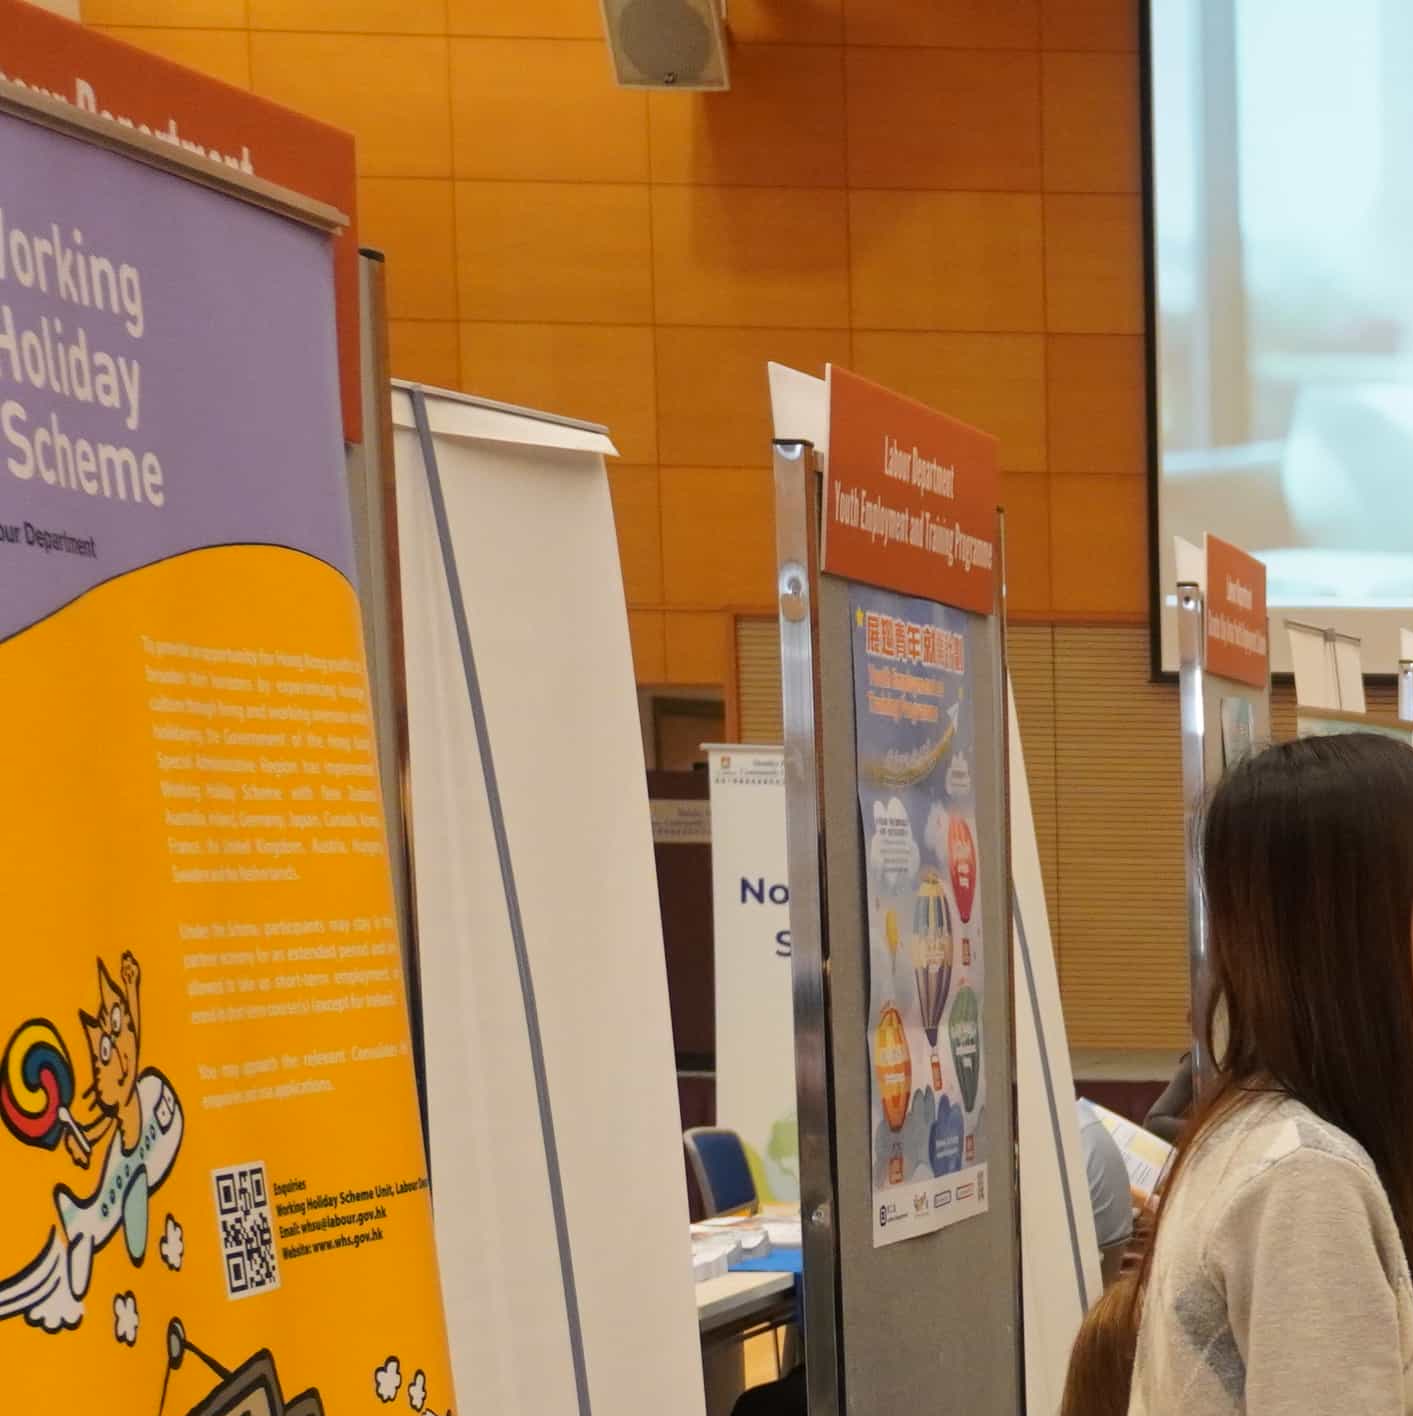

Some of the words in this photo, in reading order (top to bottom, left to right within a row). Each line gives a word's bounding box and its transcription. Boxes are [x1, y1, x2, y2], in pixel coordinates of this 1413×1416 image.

[0, 207, 144, 338] orking
[0, 305, 142, 430] Holiday
[1, 400, 165, 507] Scheme
[884, 434, 911, 482] Labour
[912, 446, 954, 499] Department
[0, 522, 20, 544] our
[23, 521, 97, 559] Department
[835, 480, 859, 528] Youth
[861, 489, 909, 547] Employment
[909, 511, 924, 548] and
[924, 512, 954, 566] Training
[740, 877, 790, 905] No
[273, 1178, 306, 1197] Enquiries
[276, 1202, 307, 1217] Working
[306, 1193, 338, 1210] Holiday
[340, 1190, 374, 1205] Scheme
[394, 1180, 417, 1194] Labour
